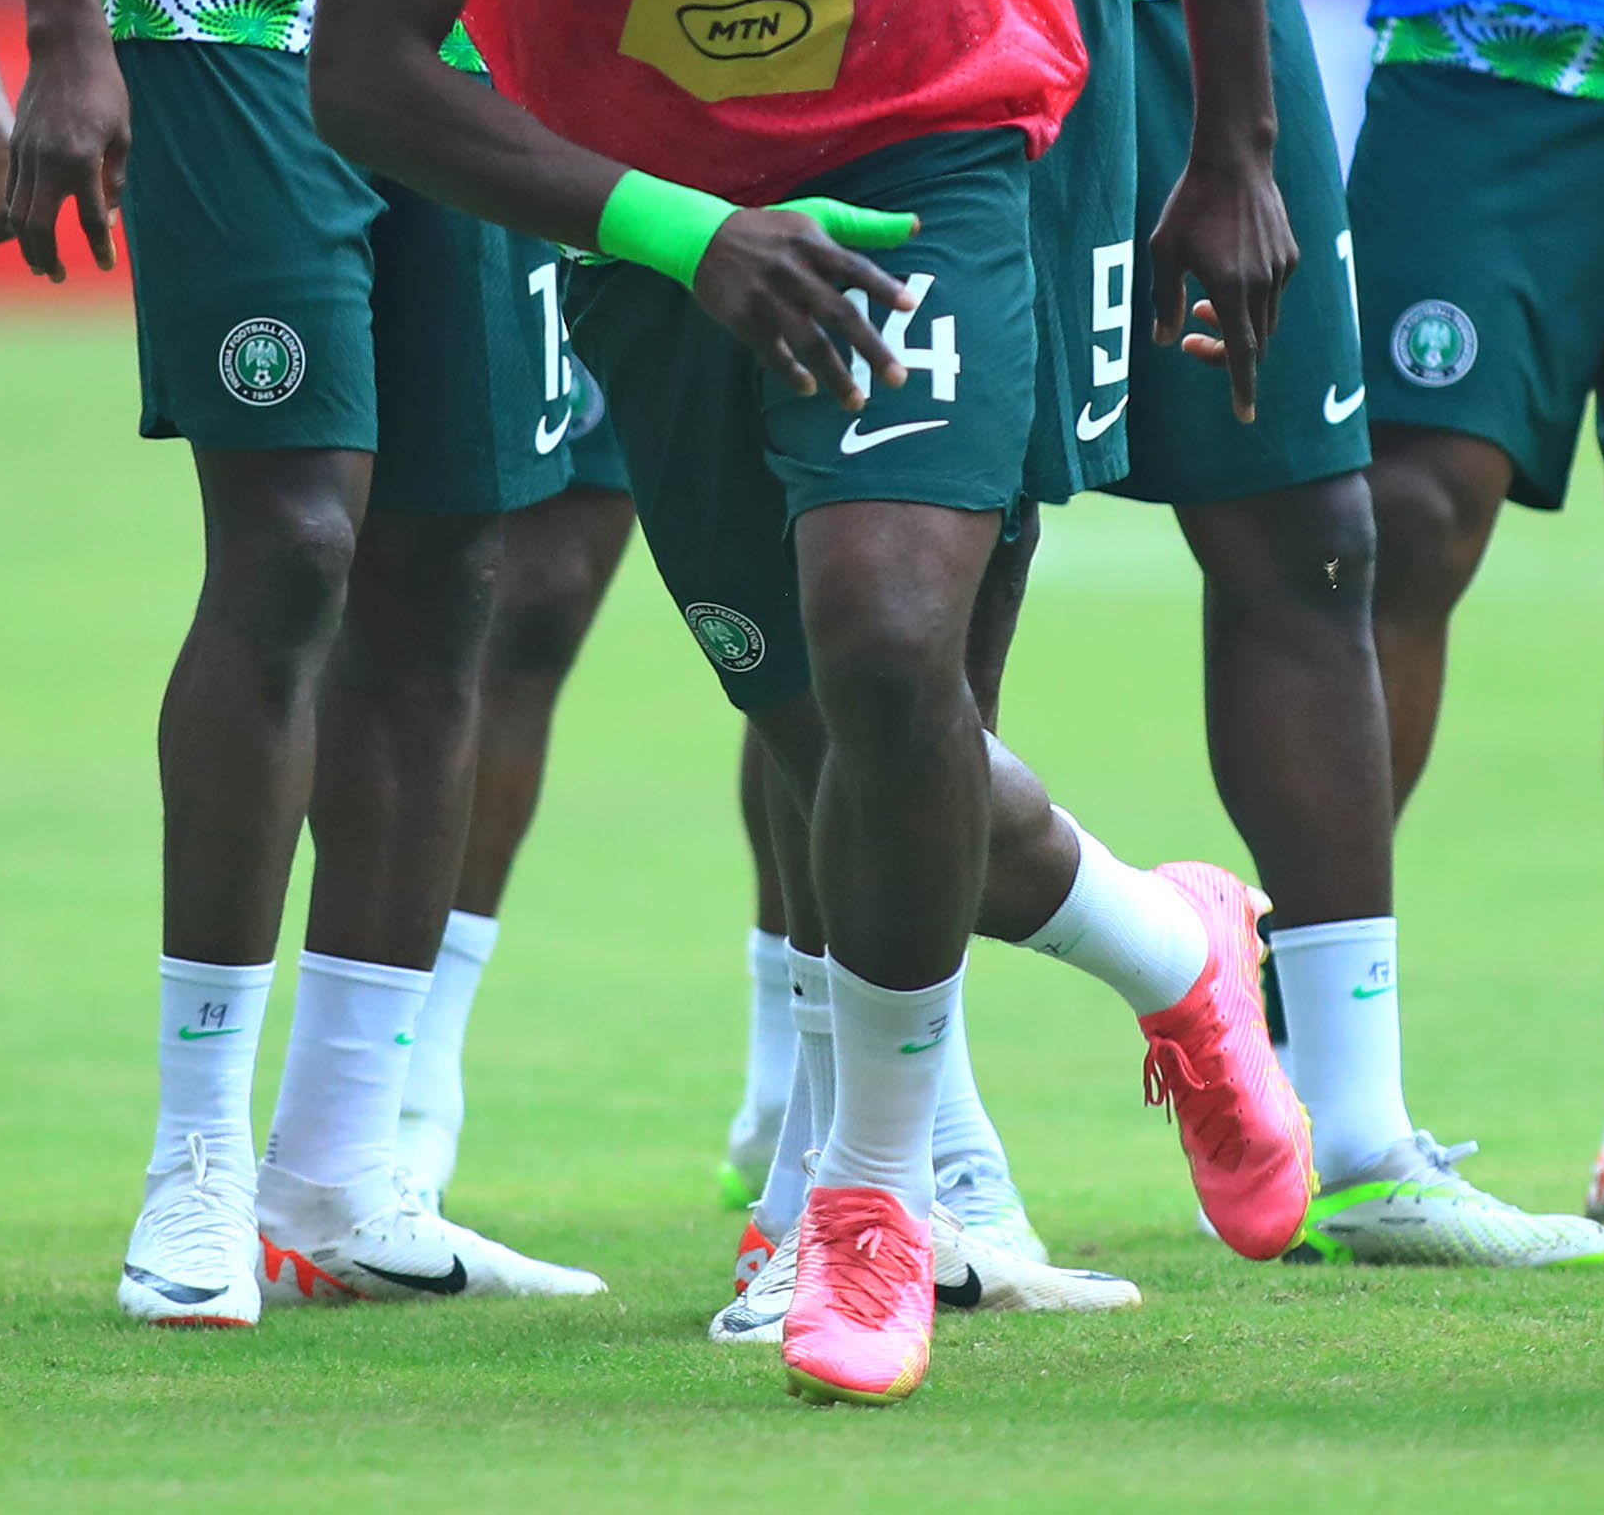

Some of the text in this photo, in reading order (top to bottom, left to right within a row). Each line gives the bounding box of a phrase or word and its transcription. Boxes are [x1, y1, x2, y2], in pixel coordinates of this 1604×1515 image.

[707, 12, 781, 42] MTN
[528, 262, 573, 402] 1
[1093, 239, 1134, 386] 9
[229, 323, 278, 349] FOOTBALL
[278, 329, 300, 389] FEDERATION
[252, 389, 275, 400] 1945
[199, 1001, 228, 1028] 19
